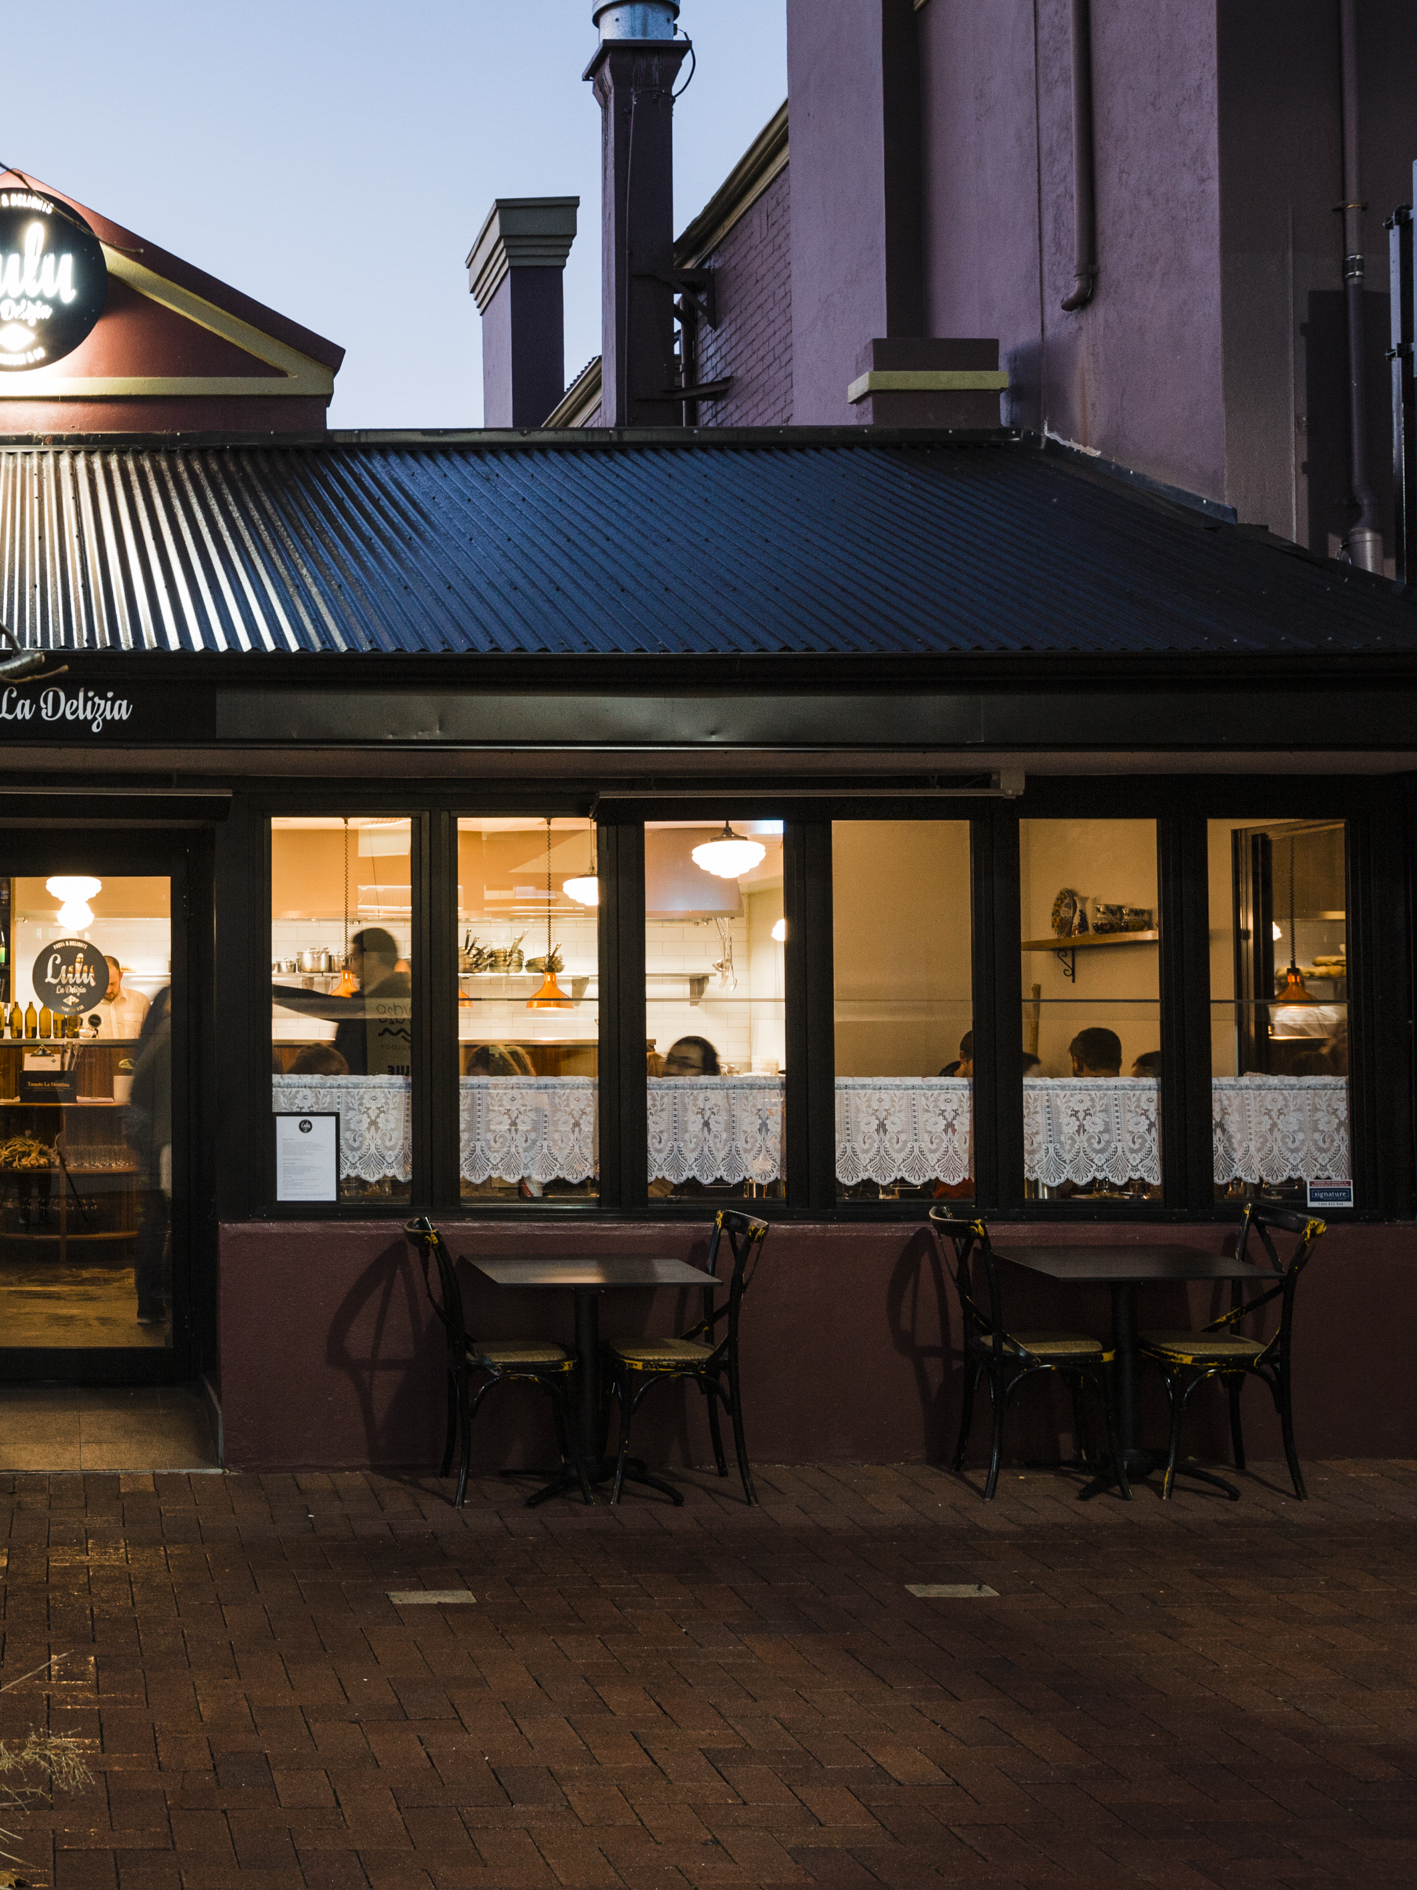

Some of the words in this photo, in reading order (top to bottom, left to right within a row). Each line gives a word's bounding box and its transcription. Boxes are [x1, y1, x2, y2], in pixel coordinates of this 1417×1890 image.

[0, 686, 36, 720] La
[39, 686, 133, 733] Delizia
[44, 952, 97, 987] Lulu
[56, 985, 65, 994] La
[1314, 1191, 1347, 1199] signature
